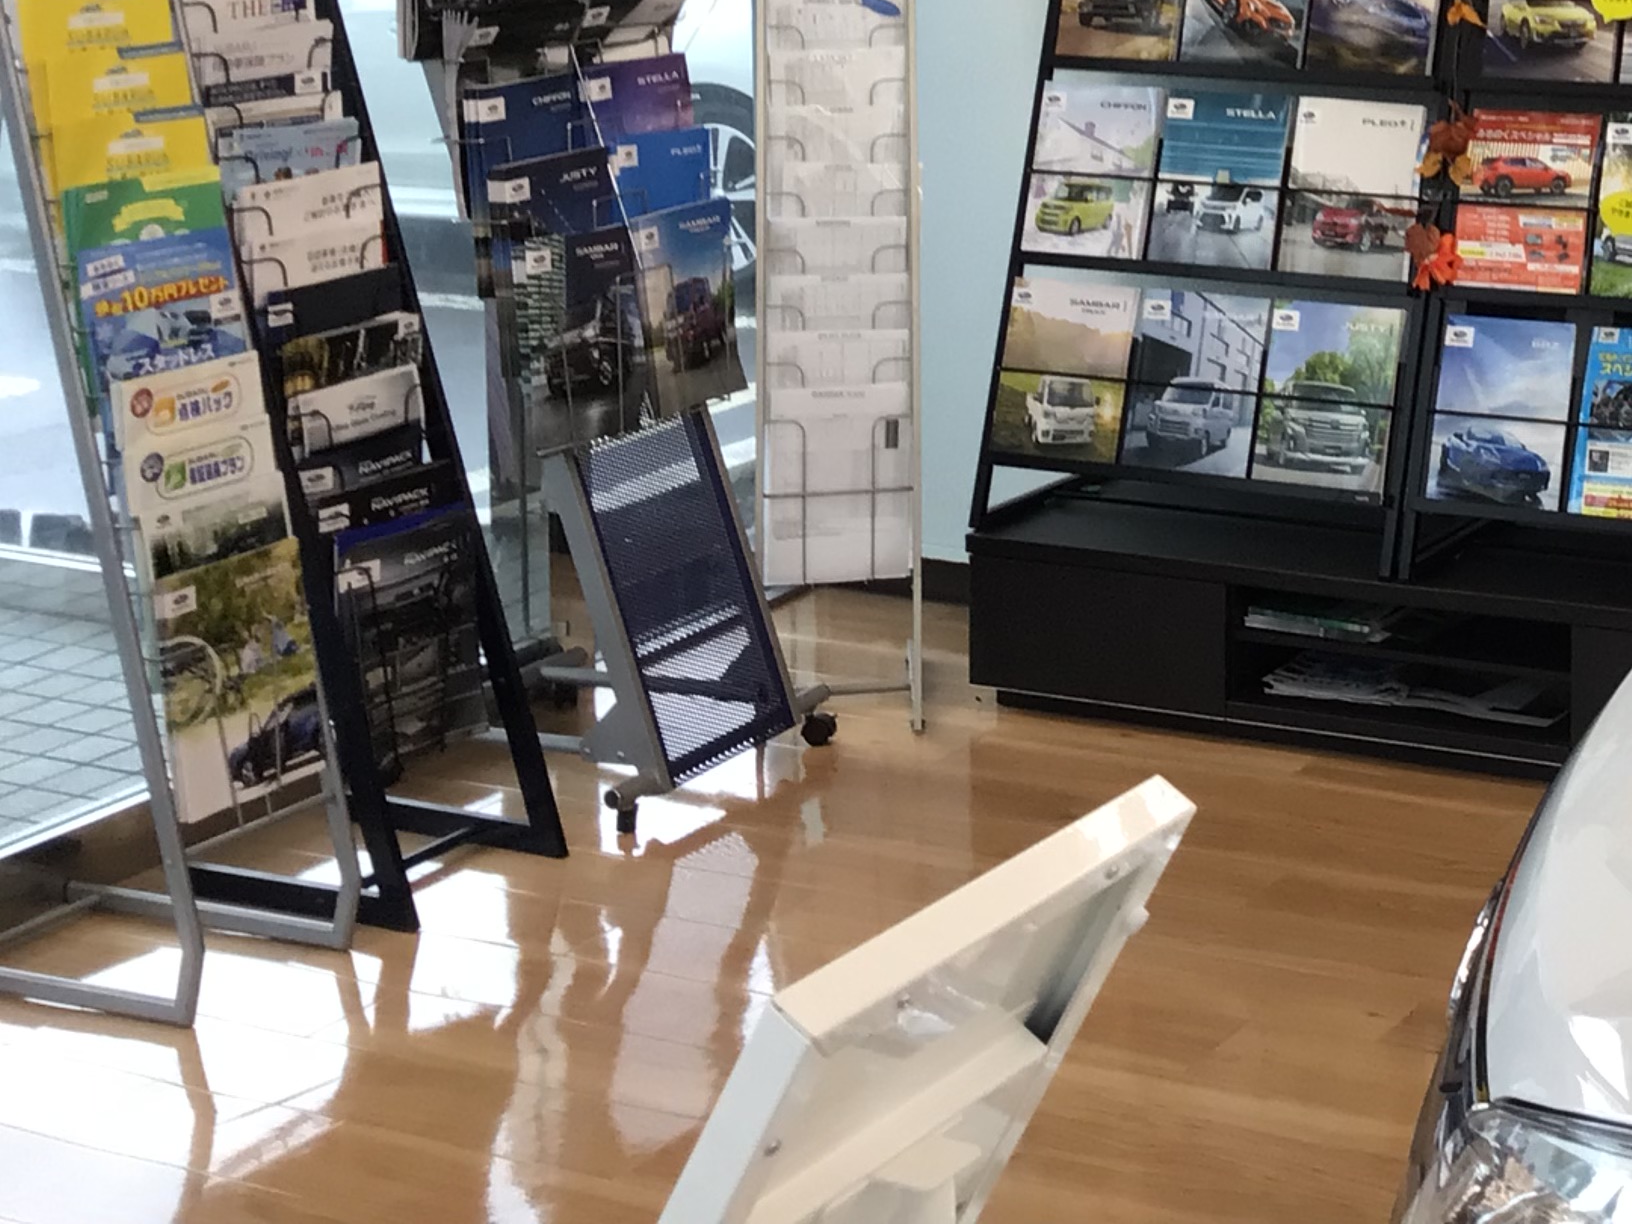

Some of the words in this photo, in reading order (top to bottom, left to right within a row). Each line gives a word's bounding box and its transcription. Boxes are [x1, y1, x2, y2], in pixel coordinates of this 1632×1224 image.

[1100, 101, 1147, 111] CHIFFON
[1225, 107, 1277, 120] STELLA
[560, 166, 598, 183] JUSTY
[1069, 297, 1121, 311] SAMBAR
